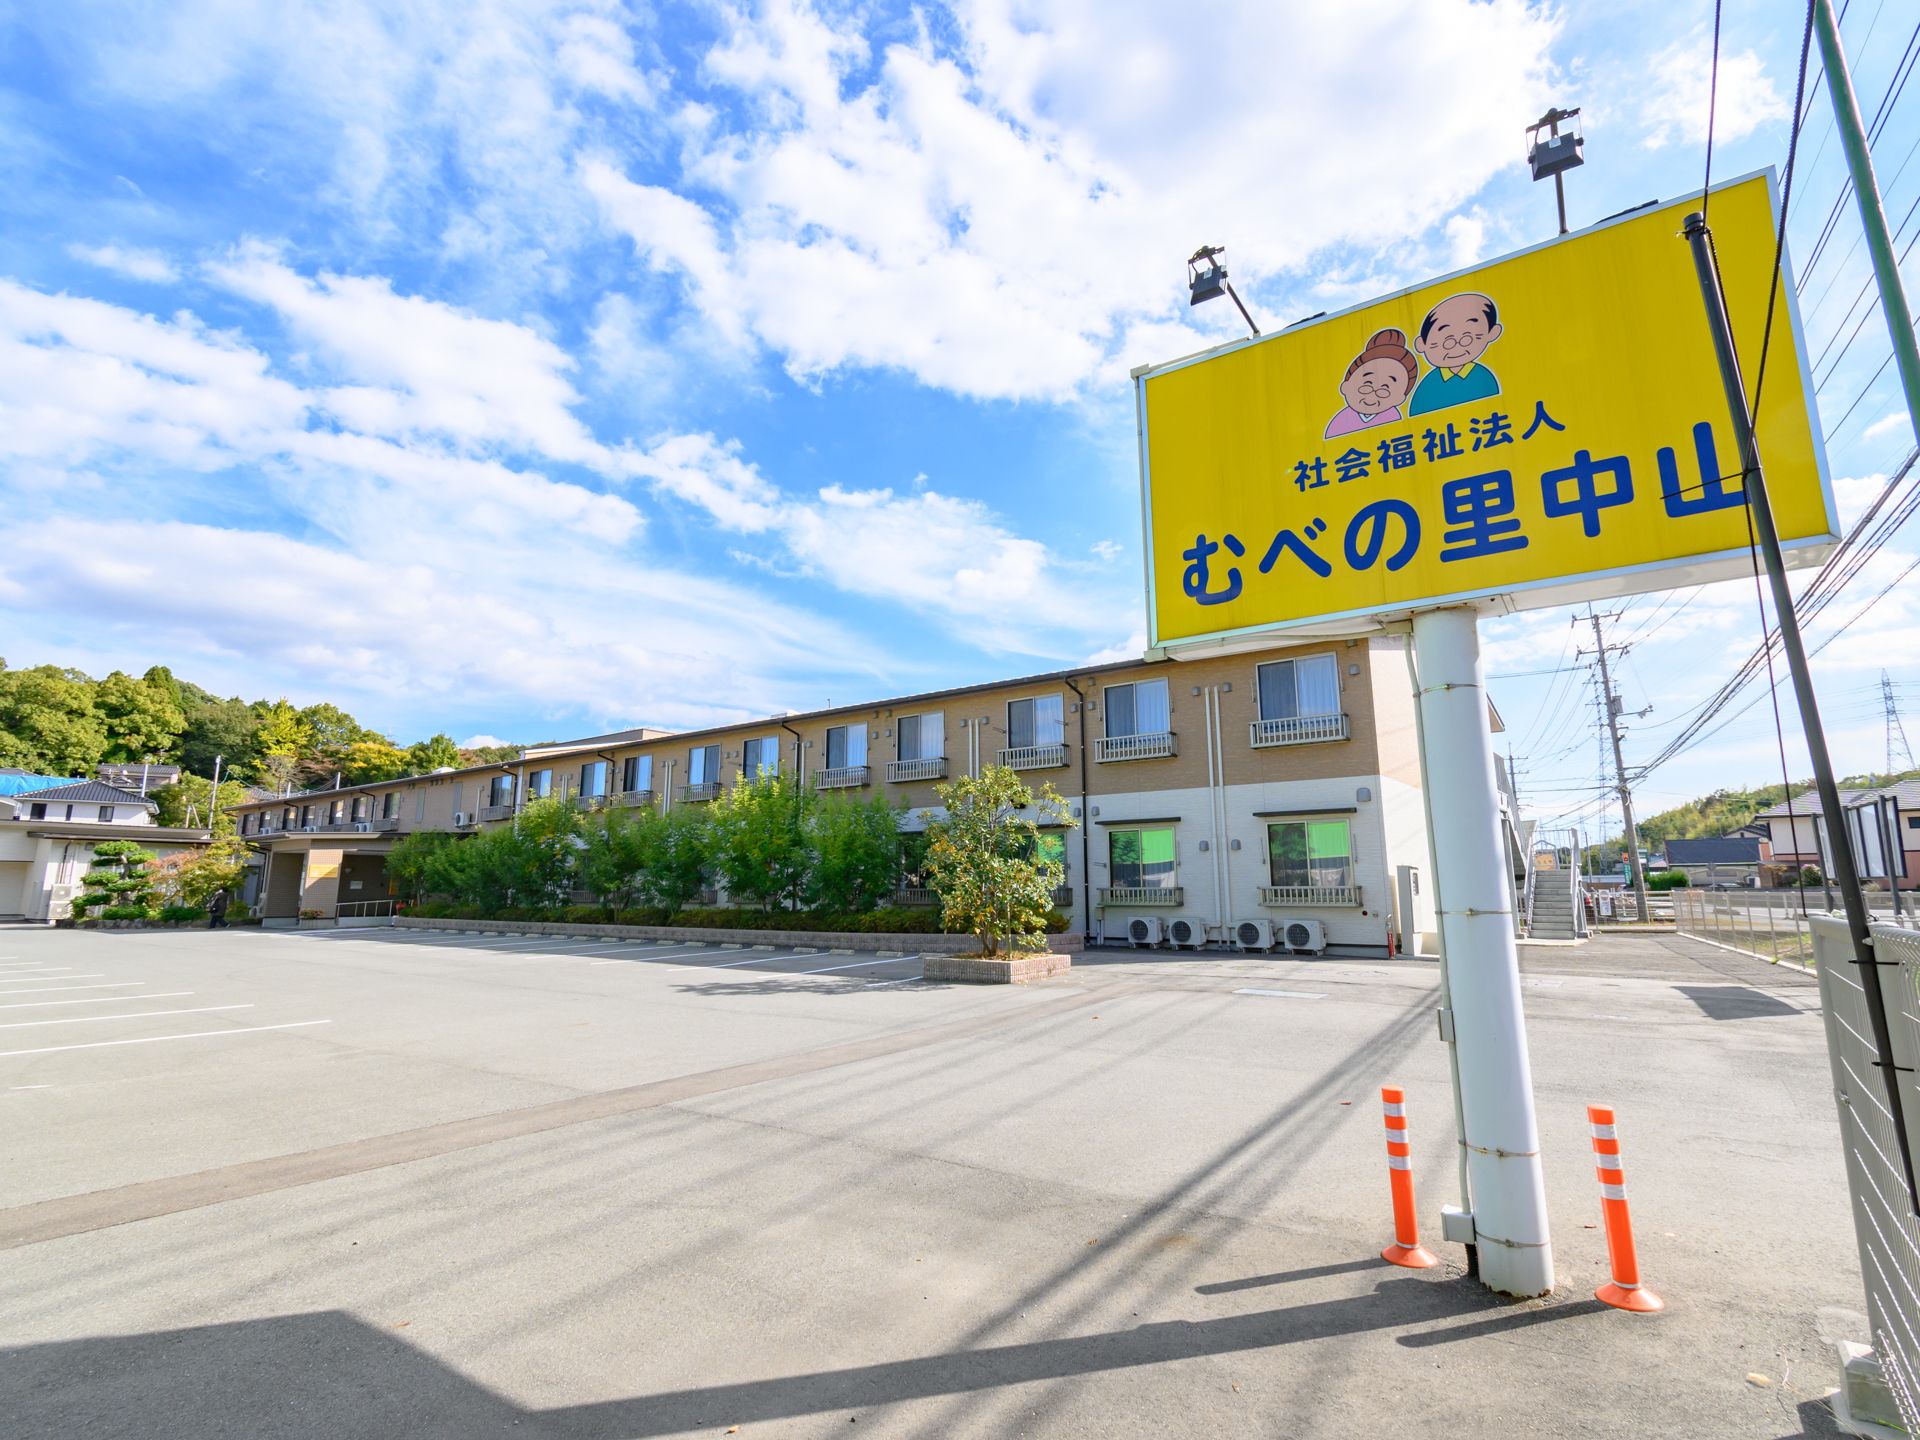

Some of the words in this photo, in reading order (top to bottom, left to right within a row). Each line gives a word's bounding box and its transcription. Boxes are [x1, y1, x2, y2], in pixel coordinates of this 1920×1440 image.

[1182, 421, 1752, 606] むべの里中山
[1293, 400, 1565, 493] 社会福祉法人
